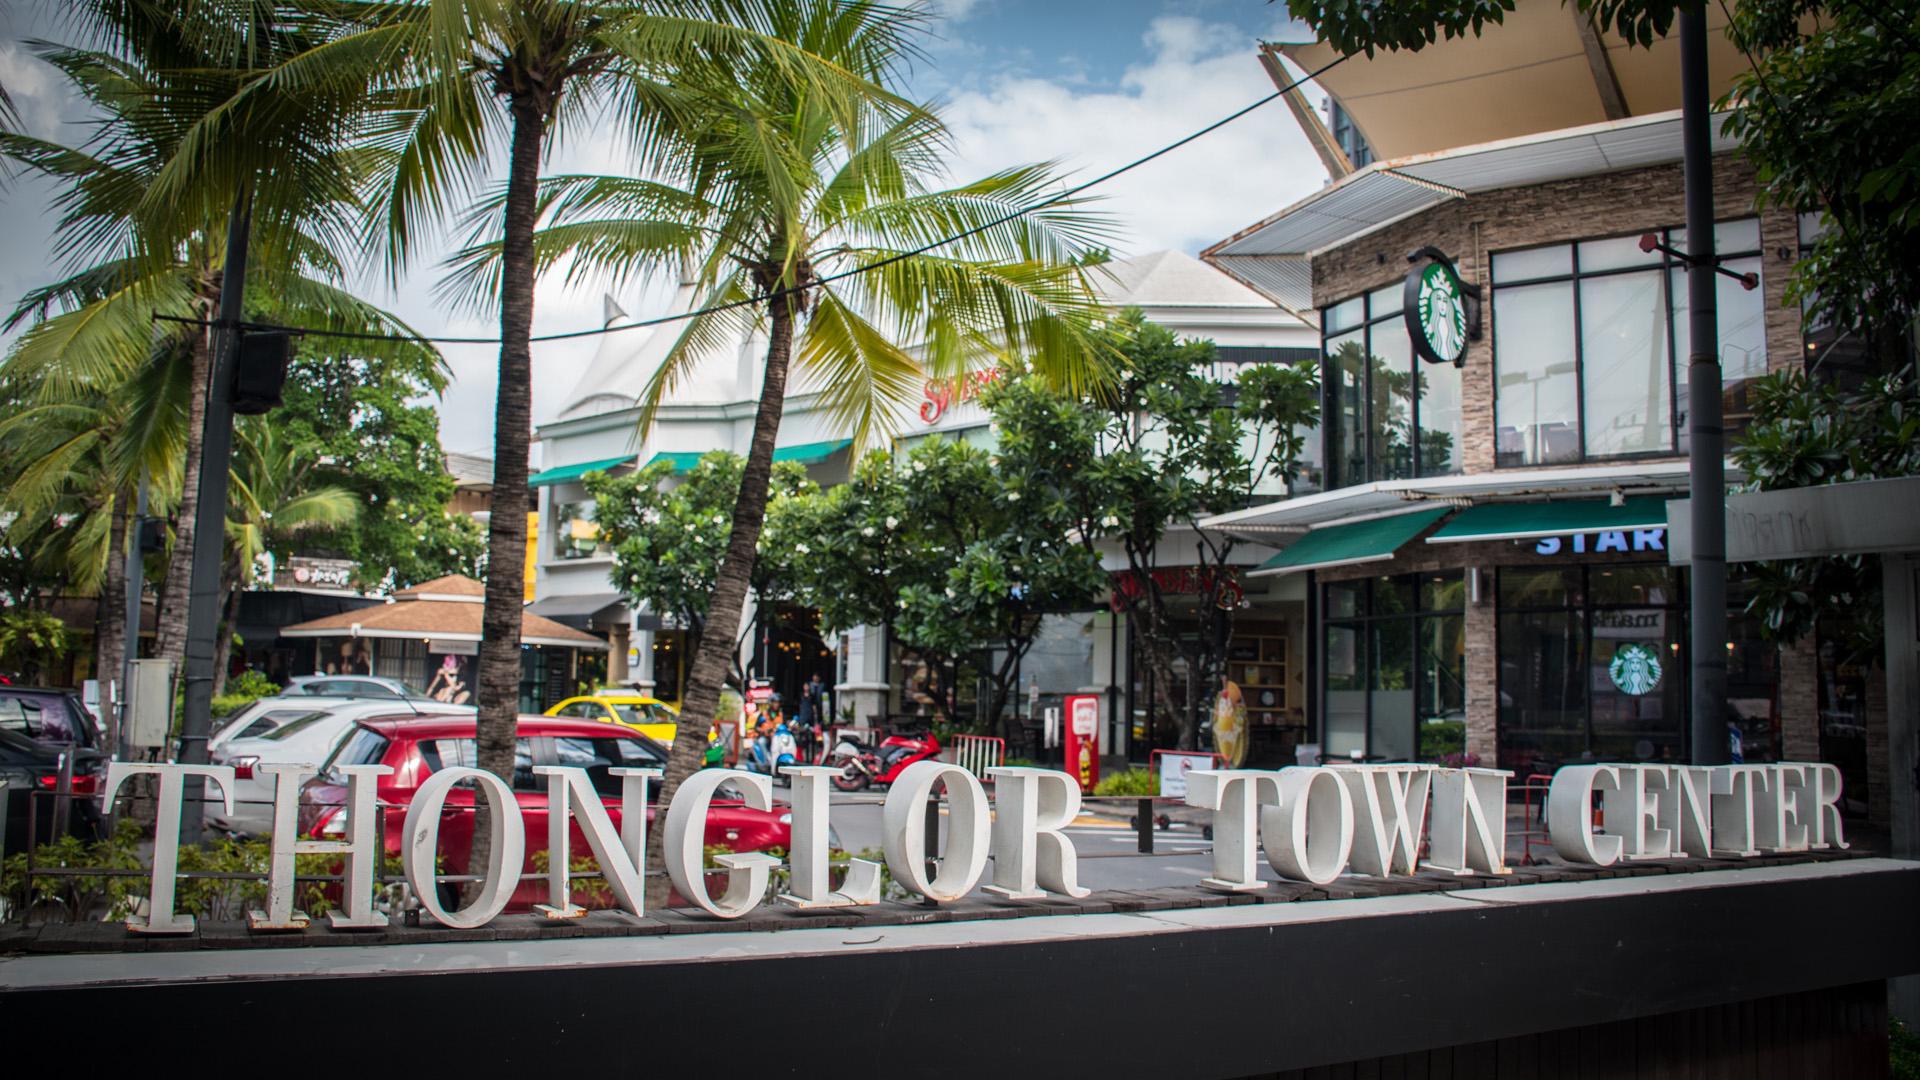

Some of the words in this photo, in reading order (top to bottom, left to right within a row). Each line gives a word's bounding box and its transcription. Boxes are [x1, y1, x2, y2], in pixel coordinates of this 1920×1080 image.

[102, 760, 1091, 932] THONGLOR
[1187, 764, 1514, 890] TOWN
[1549, 762, 1850, 866] CENTER
